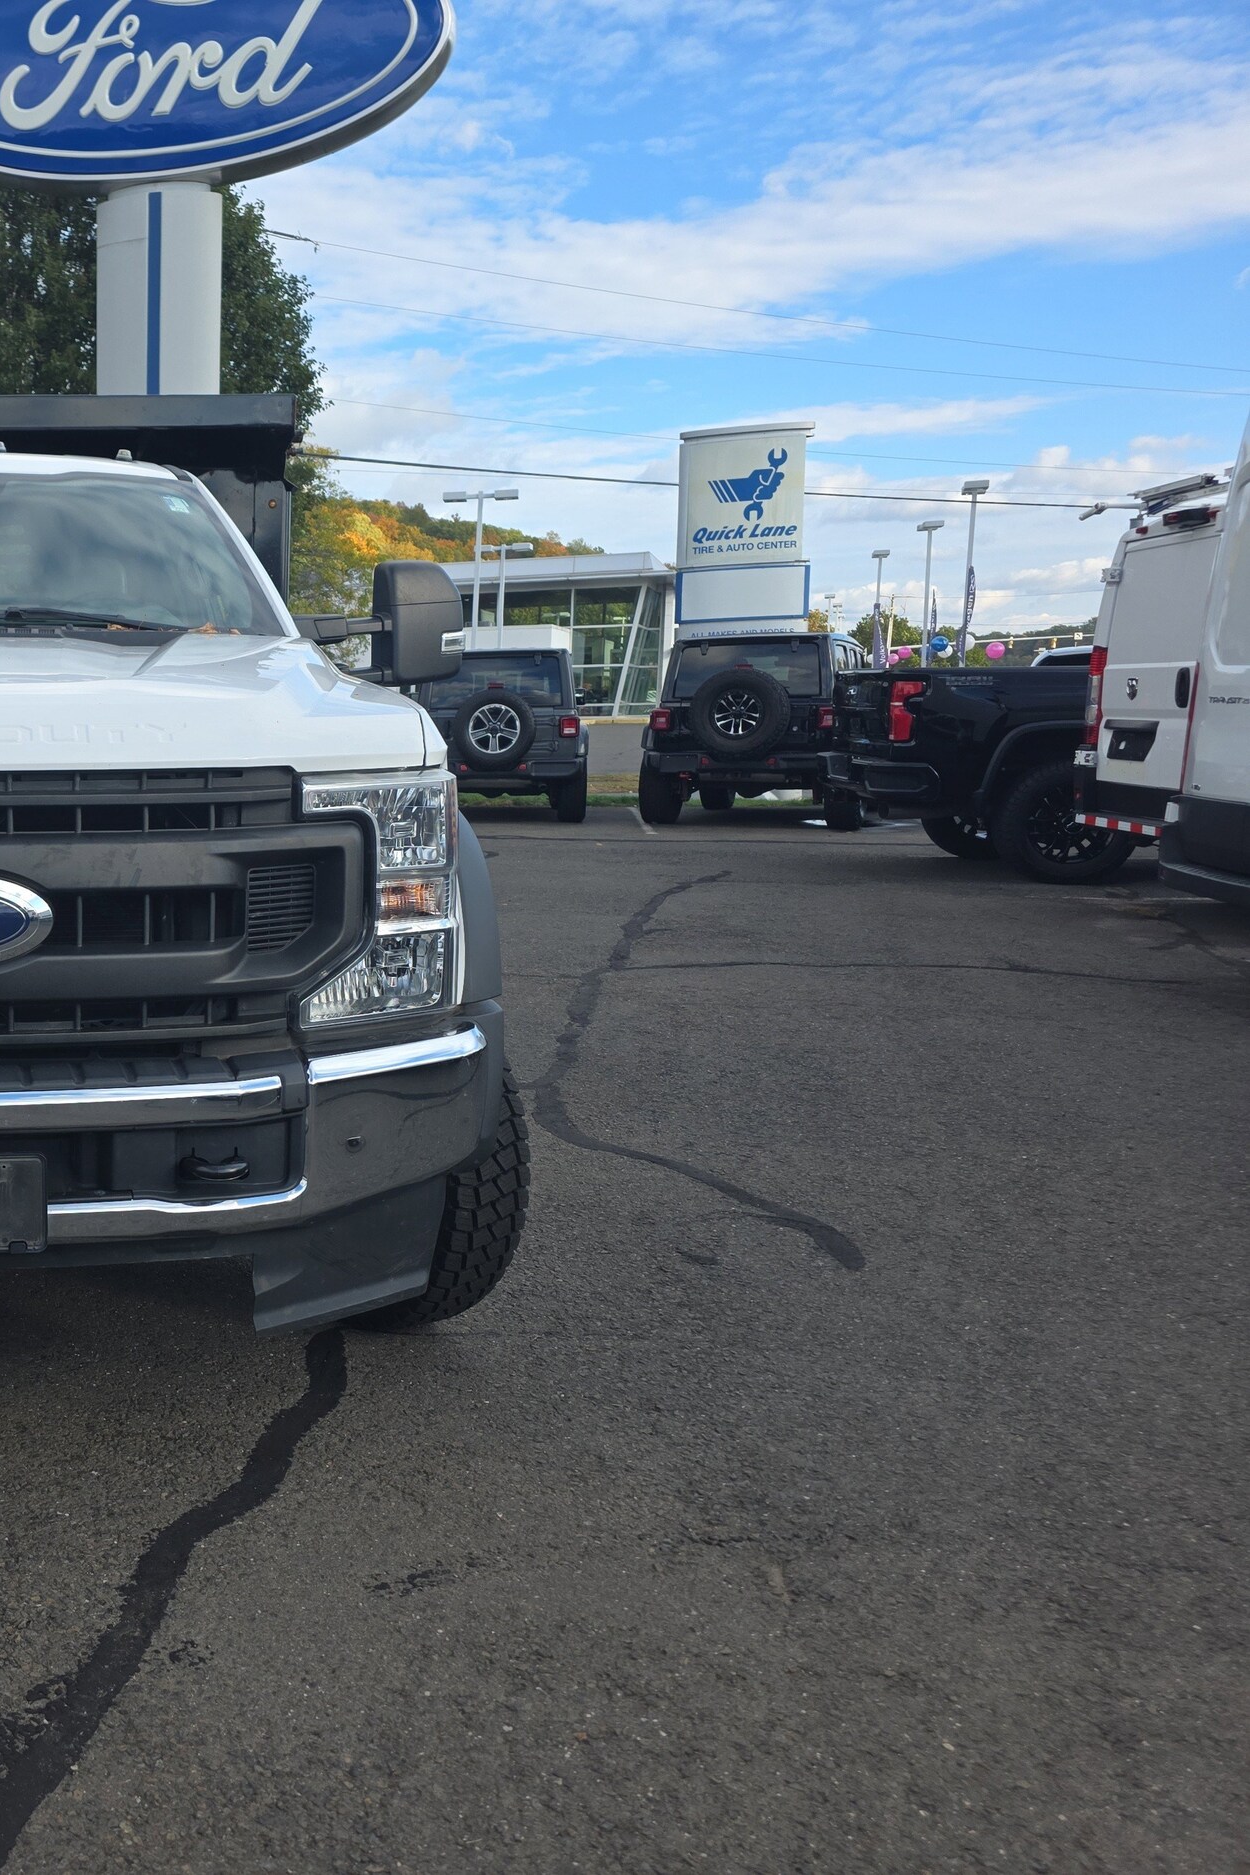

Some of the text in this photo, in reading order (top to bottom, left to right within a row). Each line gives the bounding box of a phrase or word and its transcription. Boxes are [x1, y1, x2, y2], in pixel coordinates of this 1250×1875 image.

[0, 0, 312, 131] Ford
[692, 523, 798, 544] Quick Lane
[692, 540, 797, 555] TIRE & AUTO CENTER
